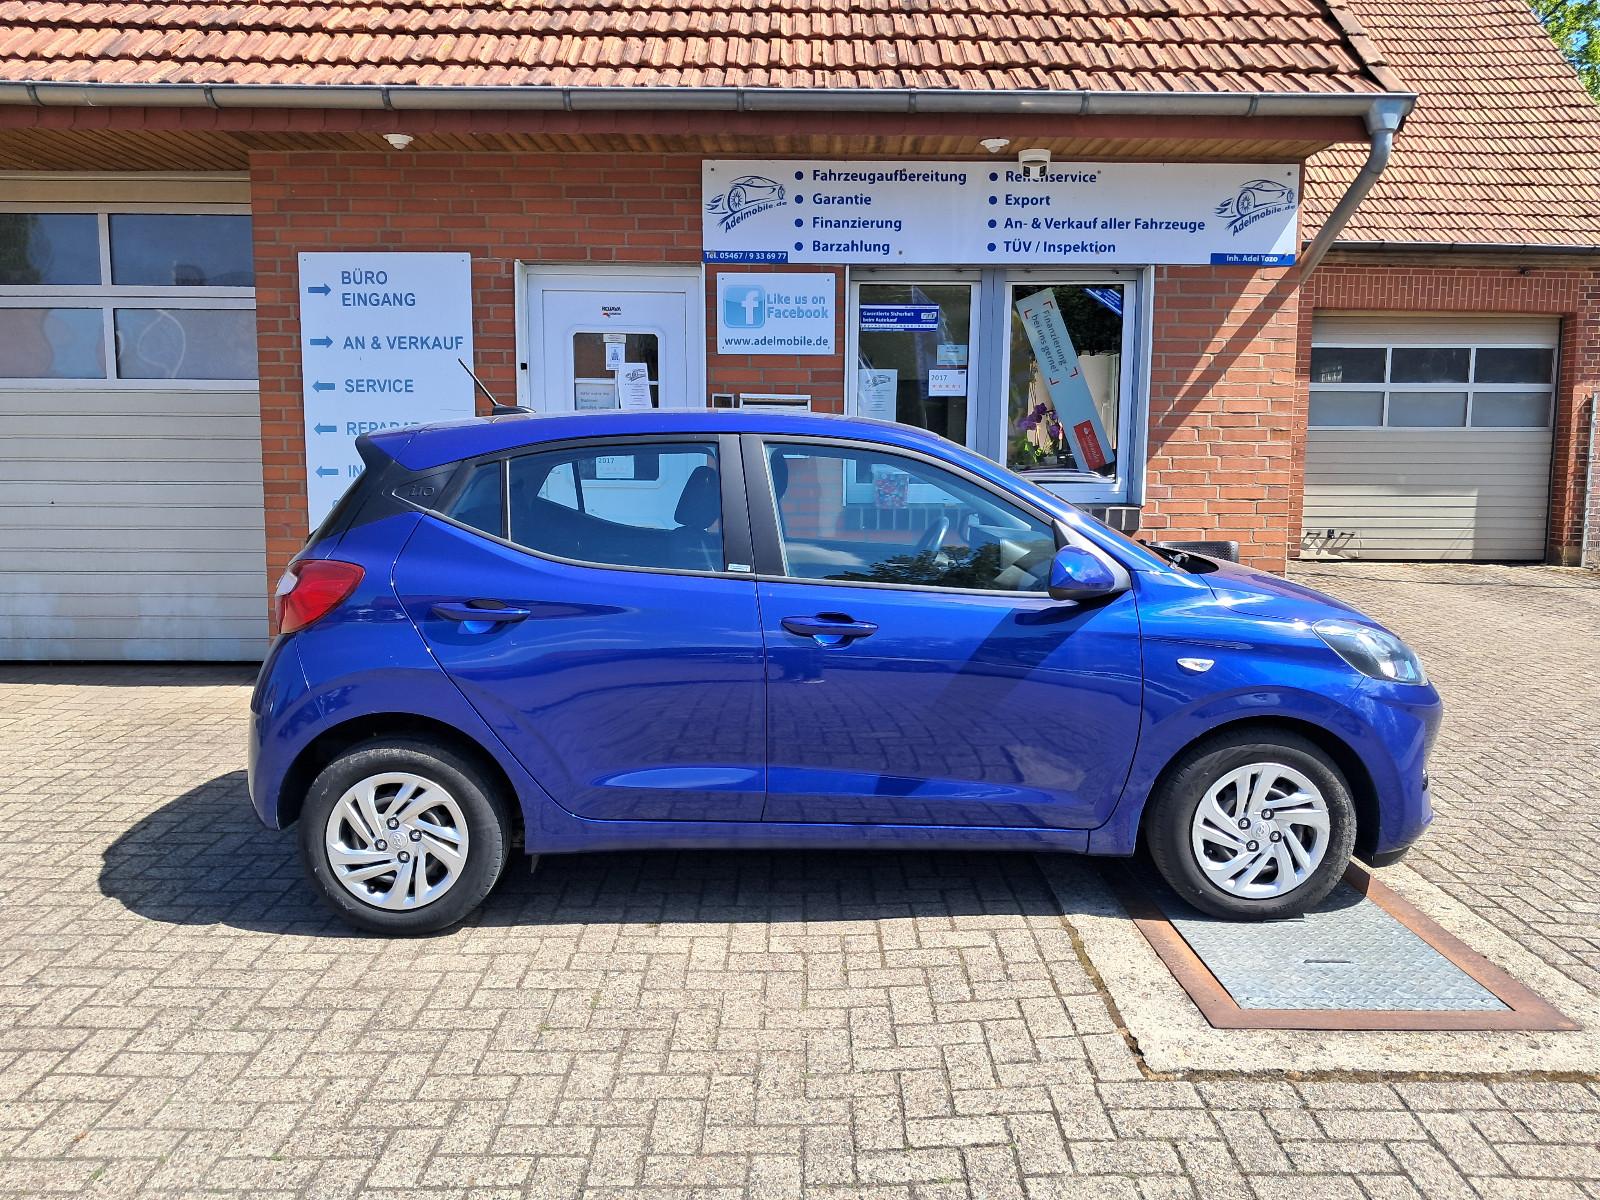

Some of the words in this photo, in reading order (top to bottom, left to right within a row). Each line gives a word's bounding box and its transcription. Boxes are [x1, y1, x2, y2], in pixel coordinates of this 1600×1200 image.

[813, 169, 967, 185] Fahrzeugaufbereitung
[1005, 170, 1097, 183] Renservice
[813, 193, 872, 205] Garantie
[1005, 194, 1051, 208] Export
[725, 201, 787, 233] Adelmobile.de
[813, 217, 902, 232] Finanzierung
[1232, 204, 1295, 237] Adelmobile.de
[1004, 217, 1028, 229] An-
[1031, 217, 1041, 229] &
[1044, 217, 1098, 230] Verkauf
[1100, 217, 1131, 230] aller
[1134, 218, 1205, 233] Fahrzeuge
[813, 240, 890, 255] Barzahlung
[1004, 238, 1032, 253] TÜV
[1035, 241, 1040, 253] /
[1043, 241, 1116, 255] Inspektion
[719, 252, 743, 260] 05467
[749, 252, 754, 260] 9
[755, 252, 765, 260] 33
[766, 252, 776, 260] 69
[777, 252, 787, 260] 77
[1226, 254, 1241, 262] Inh.
[1242, 254, 1260, 262] Adel
[341, 268, 388, 285] BÜRO
[341, 292, 416, 307] EINGANG
[767, 293, 791, 305] Like
[795, 295, 808, 305] us
[812, 295, 826, 305] on
[767, 306, 829, 319] Facebook
[343, 336, 365, 350] AN
[371, 336, 382, 350] &
[386, 336, 464, 350] VERKAUF
[724, 336, 829, 346] www.adelmobile.de
[1037, 329, 1047, 346] uns
[1043, 310, 1067, 366] Finanzierung
[344, 379, 414, 393] SERVICE
